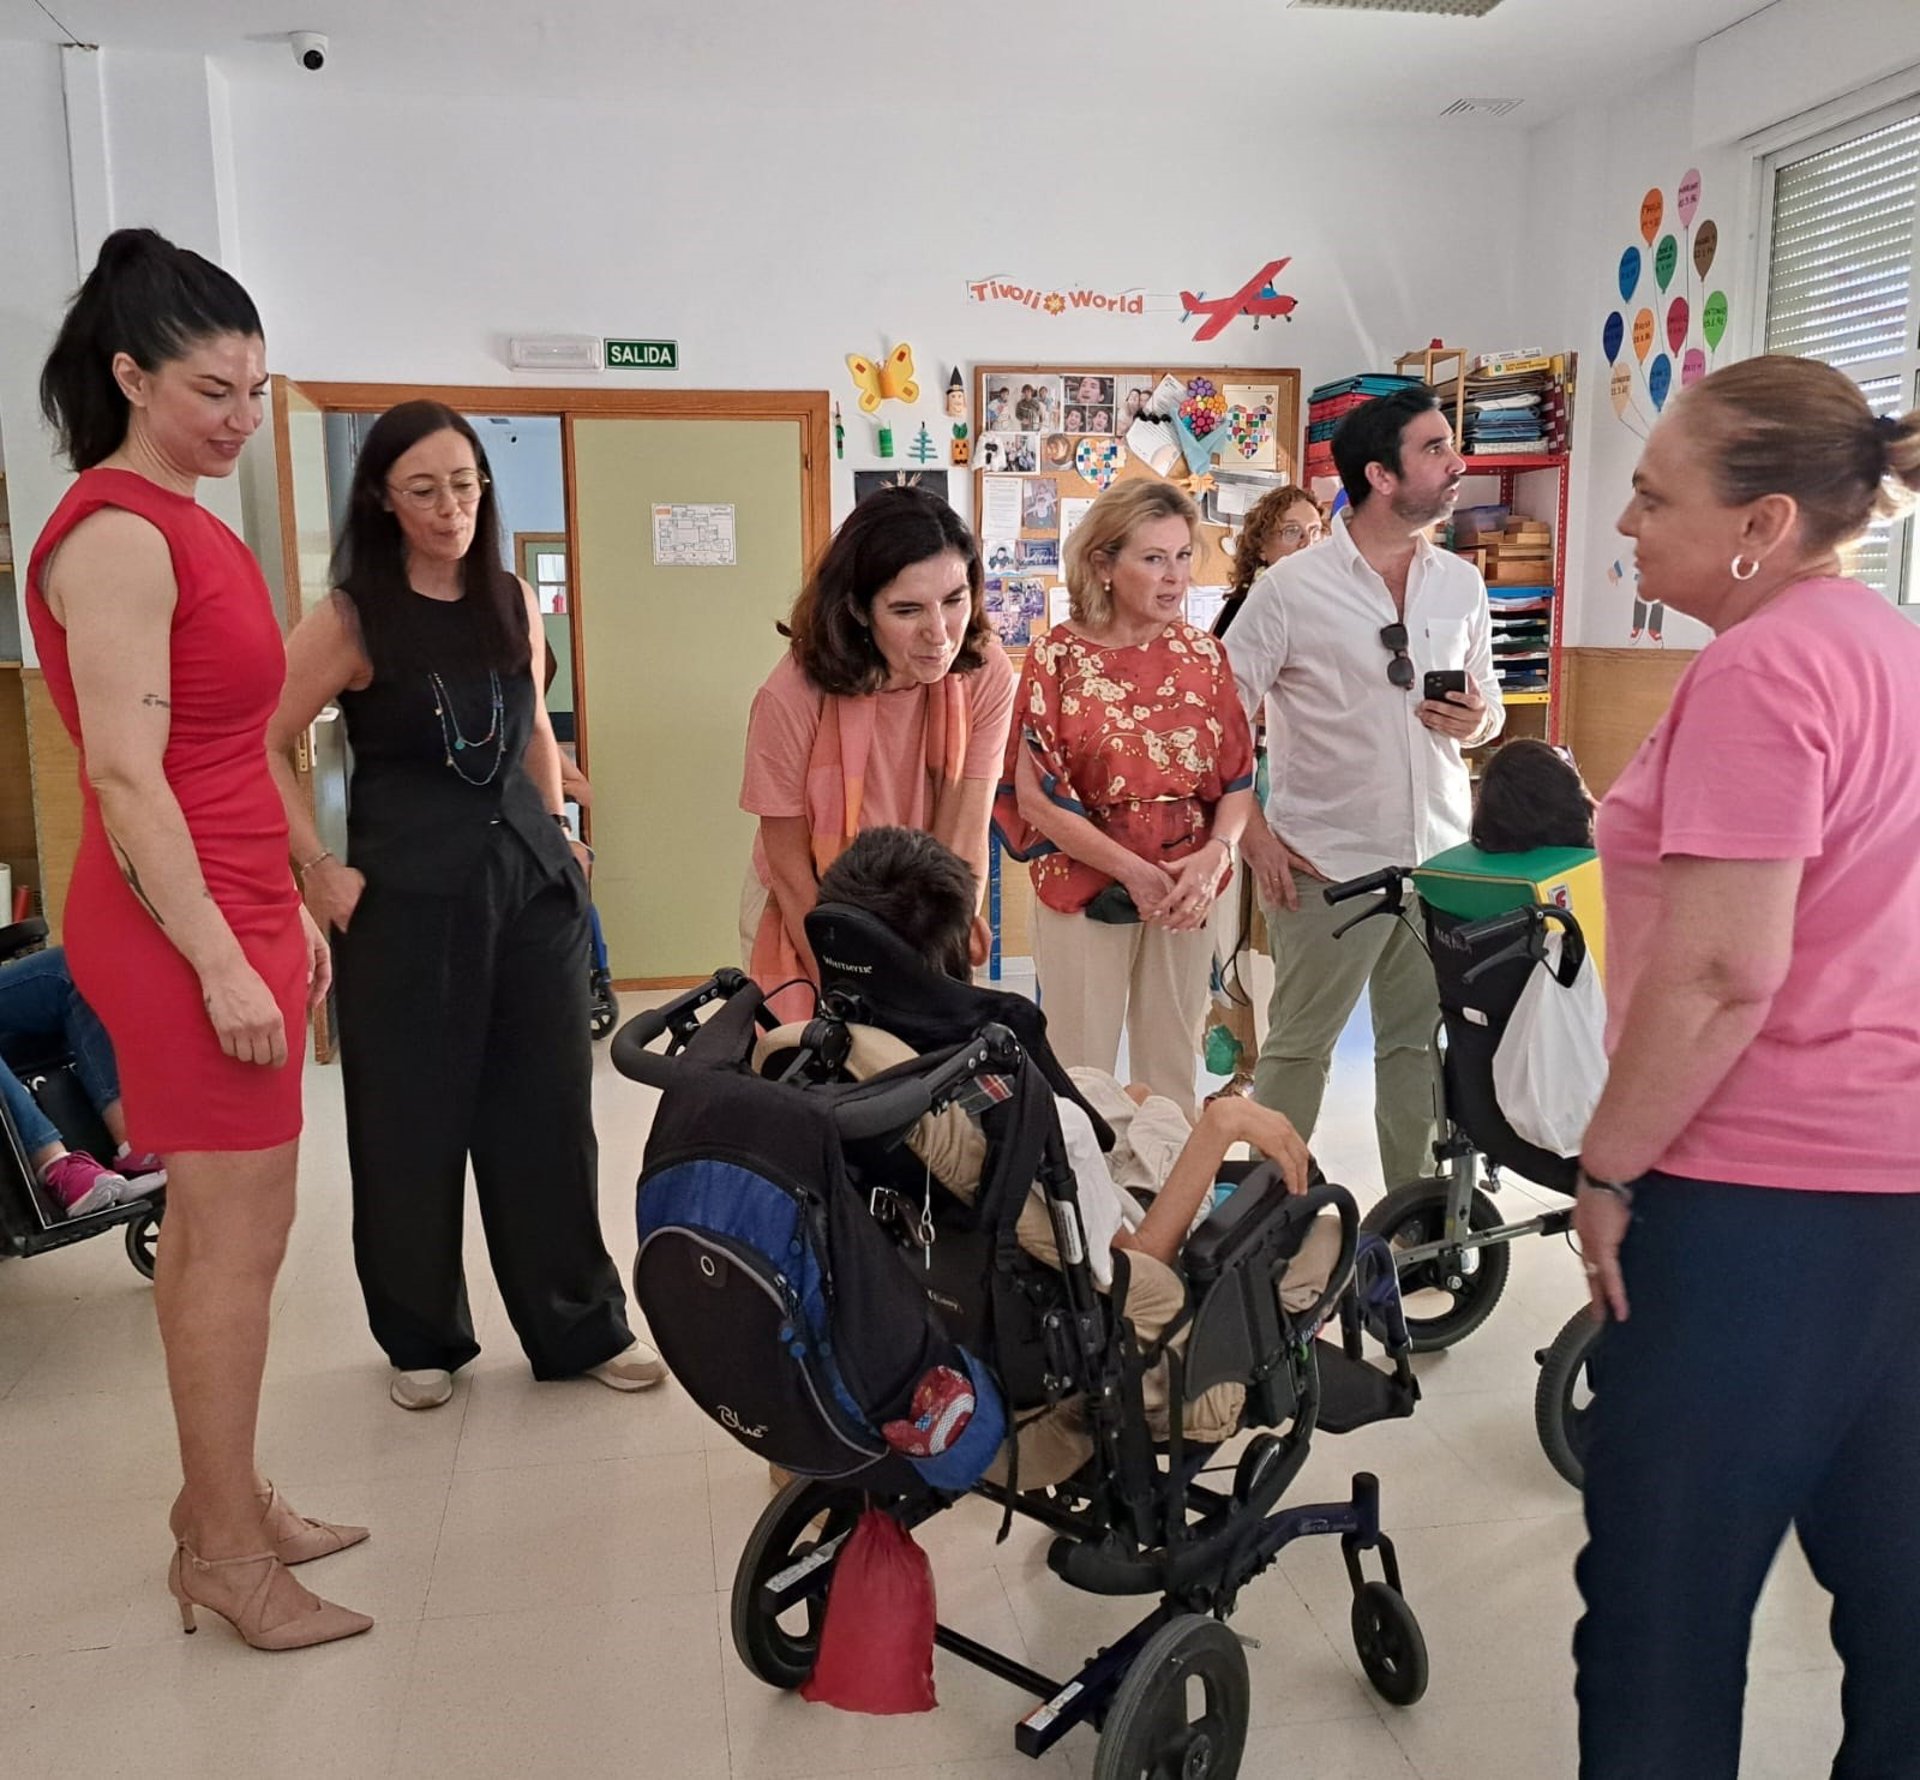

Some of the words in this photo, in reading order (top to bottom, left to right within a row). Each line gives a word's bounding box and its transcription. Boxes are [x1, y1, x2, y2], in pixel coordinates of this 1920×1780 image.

[971, 281, 1042, 310] Tivoli
[1068, 290, 1143, 314] World
[610, 345, 673, 364] SALIDA
[717, 1404, 765, 1438] Blue
